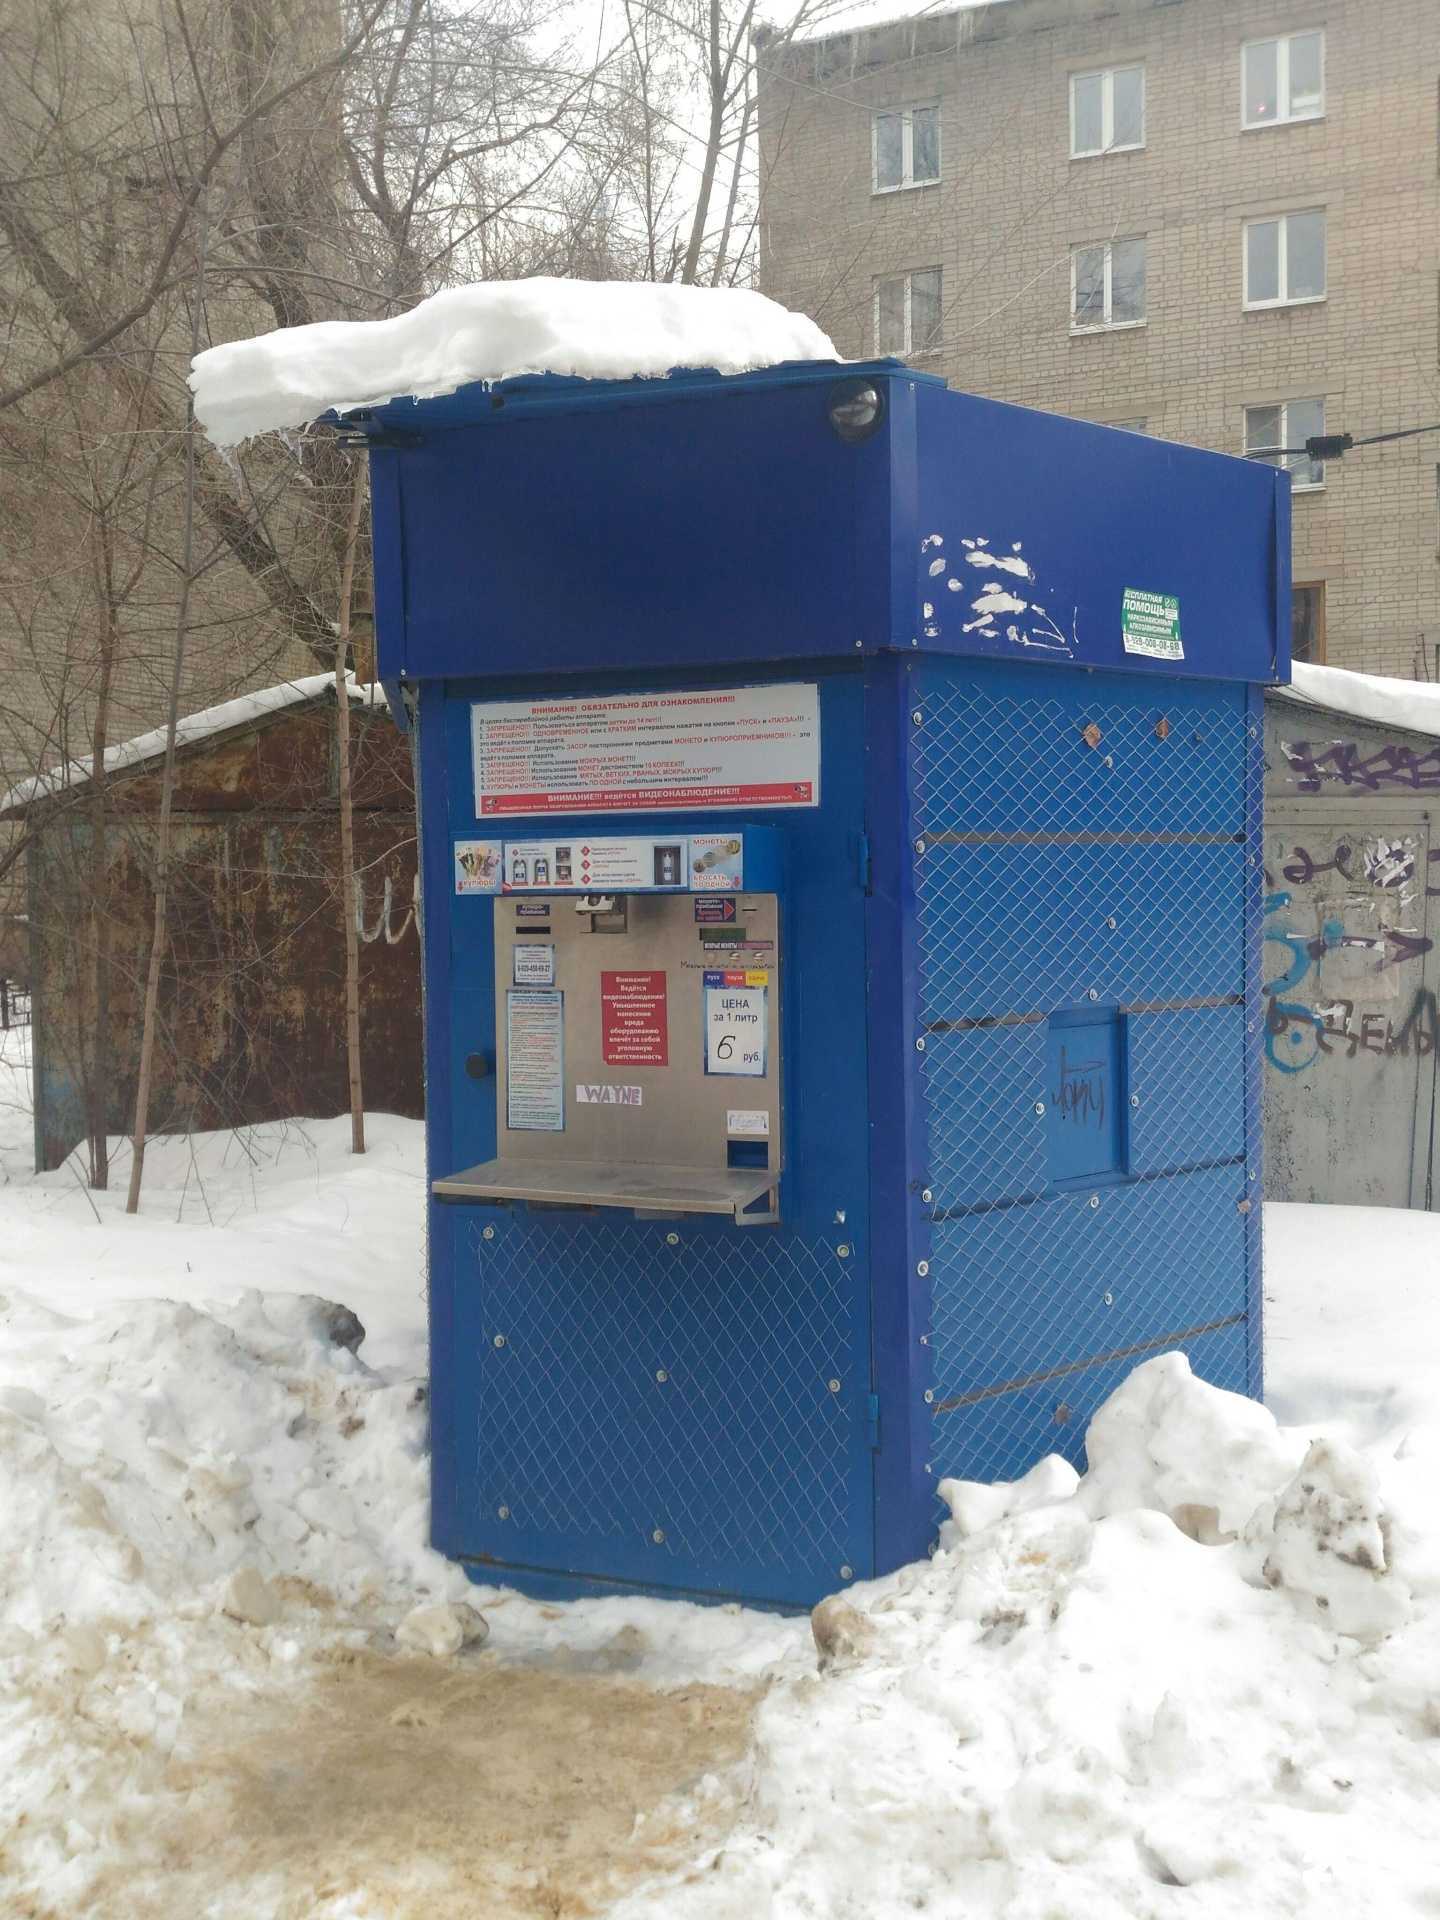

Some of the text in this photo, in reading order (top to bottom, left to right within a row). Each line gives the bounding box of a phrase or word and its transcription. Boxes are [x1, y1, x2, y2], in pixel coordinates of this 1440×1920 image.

[1123, 599, 1165, 617] ПОМОЩЬ
[531, 695, 735, 714] ВНИМАНИЕ! ОБЯЗАТЕЛЬНО ДЛЯ ОЗНАКОМЛЕНИЯ!!!
[603, 993, 665, 1001] видеонаблюдение!
[721, 999, 750, 1010] ЦЕНА
[713, 1014, 724, 1022] за
[735, 1014, 758, 1024] литр
[717, 1035, 761, 1063] 6 руб.
[584, 1086, 640, 1104] WAYNE
